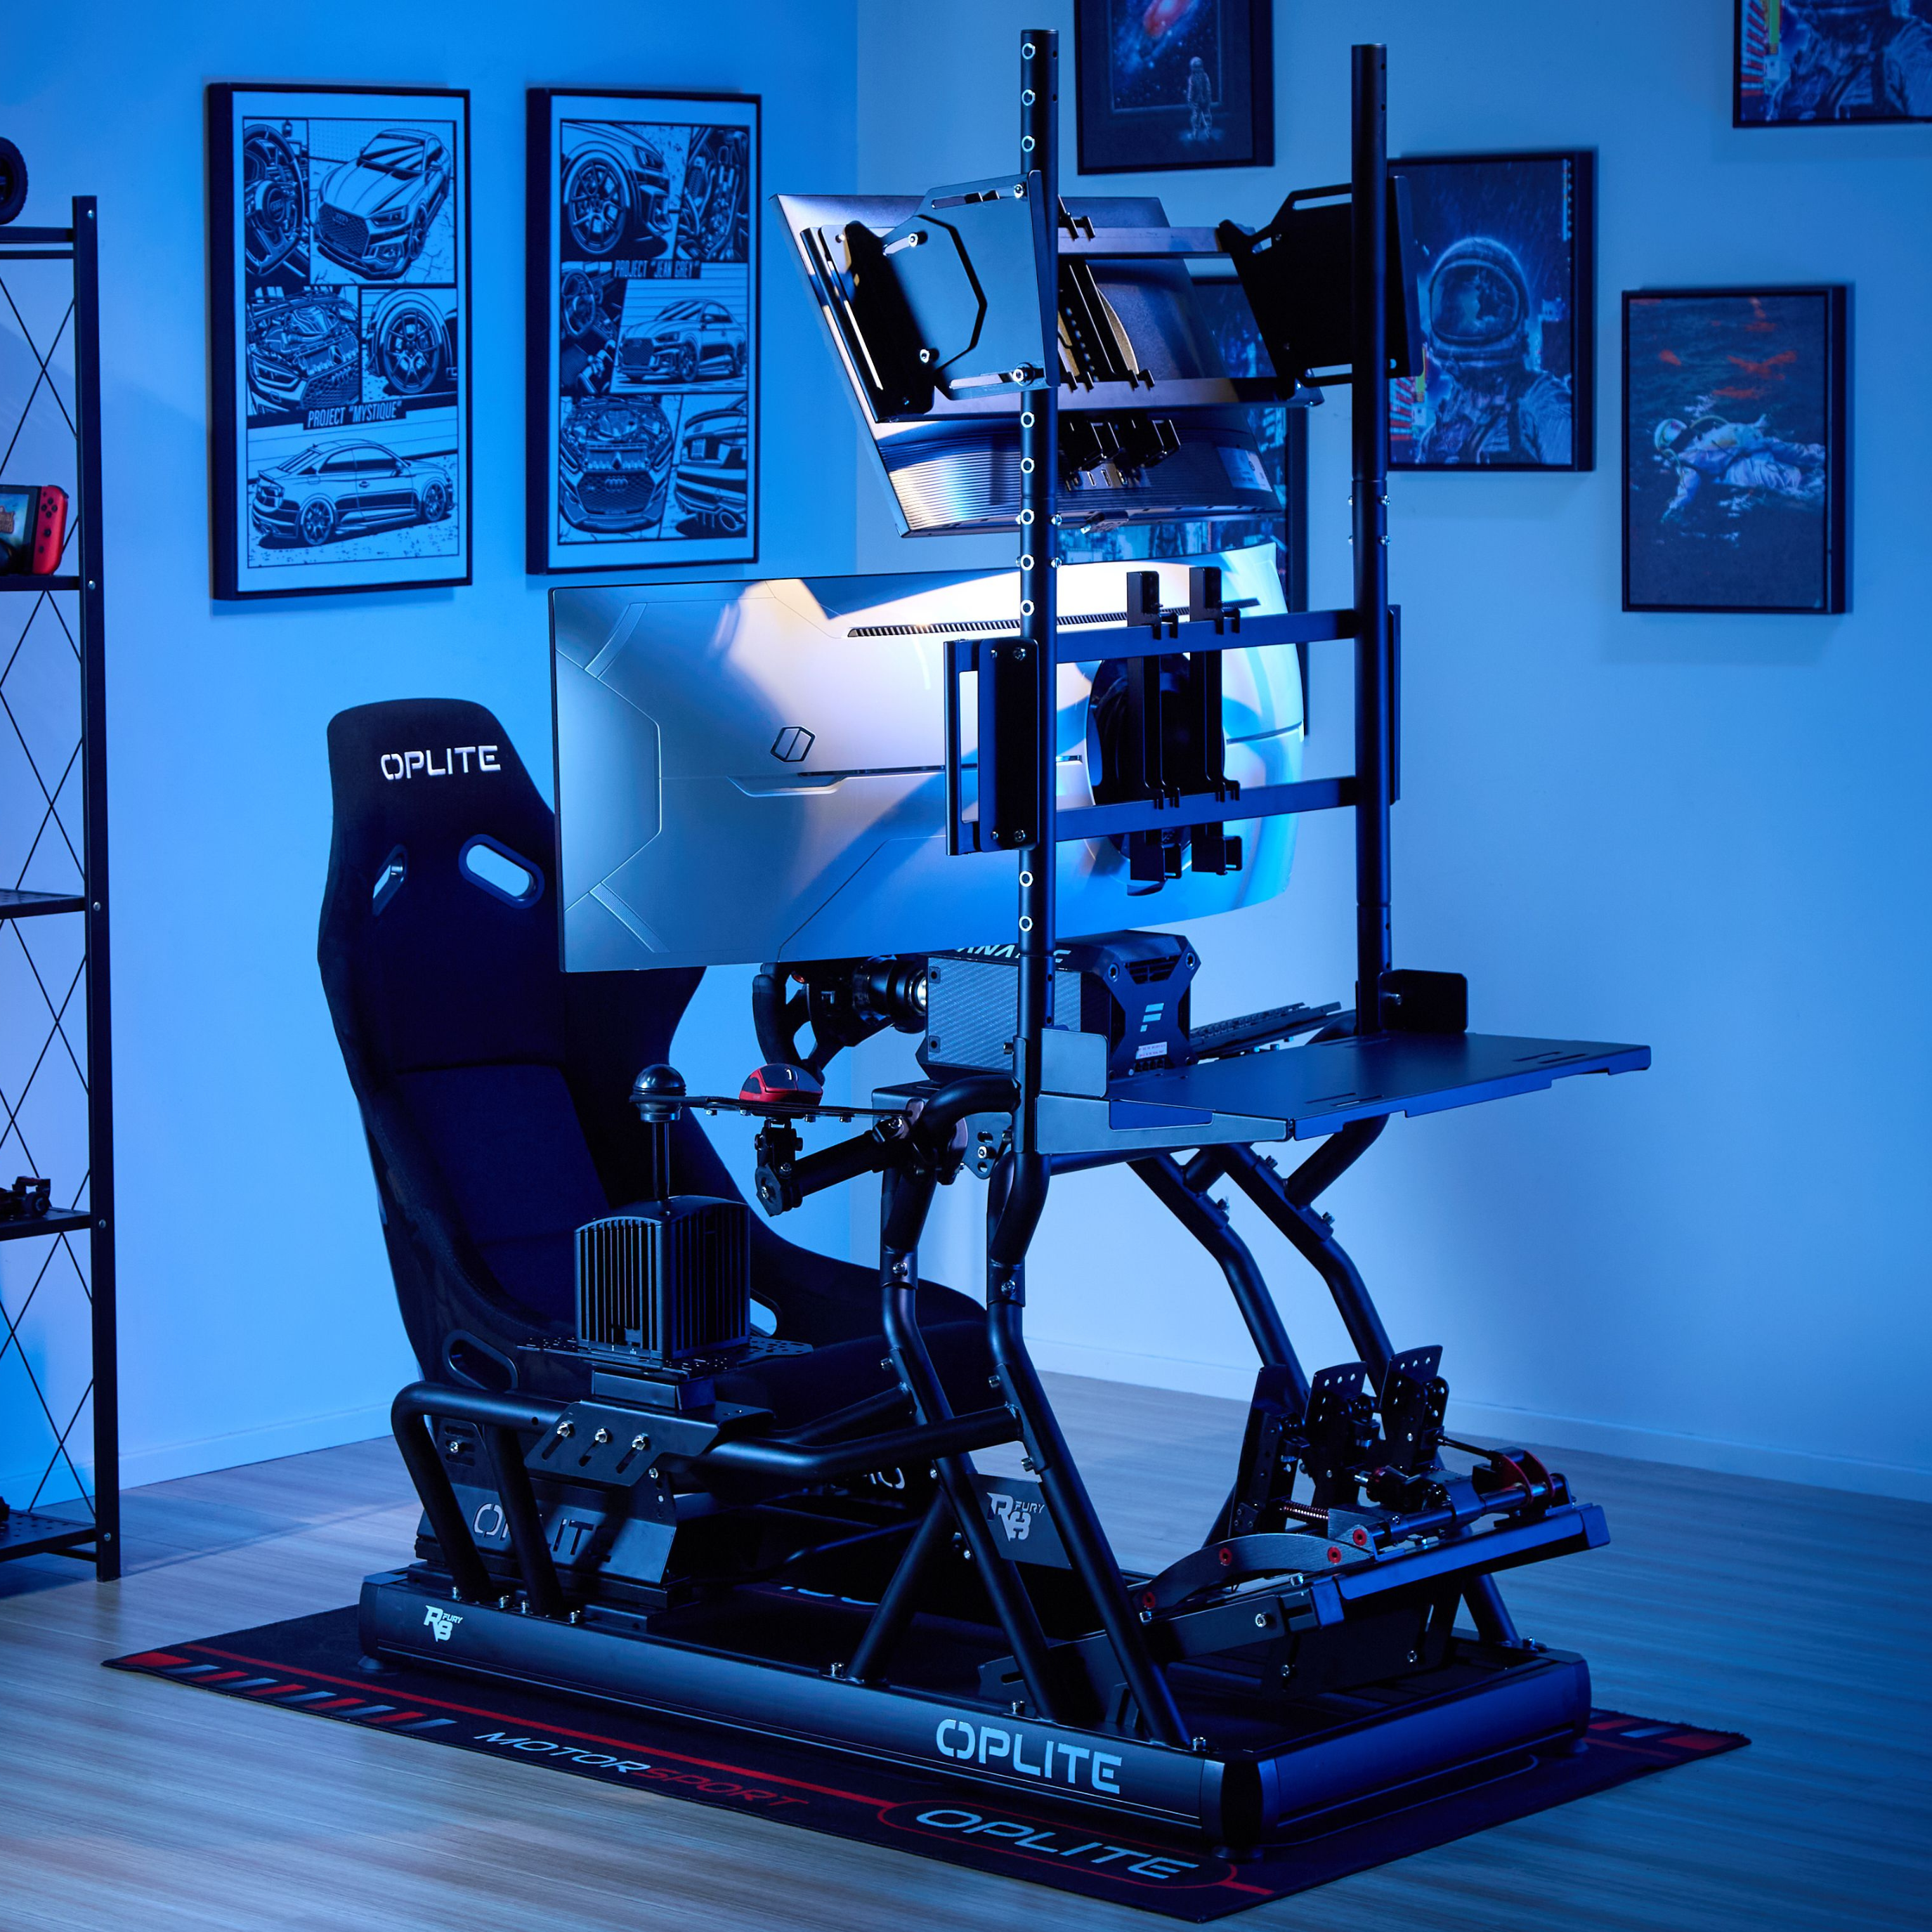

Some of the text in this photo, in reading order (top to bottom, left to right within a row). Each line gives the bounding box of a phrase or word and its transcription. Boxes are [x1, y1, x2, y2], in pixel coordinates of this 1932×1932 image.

[614, 259, 648, 278] PROJECT
[307, 407, 346, 429] PROJECT
[380, 745, 502, 781] OPLITE
[1014, 1500, 1045, 1514] FURY
[442, 1612, 463, 1624] FURY
[936, 1718, 1123, 1794] OPLITE
[916, 1809, 1200, 1879] OPLITE
